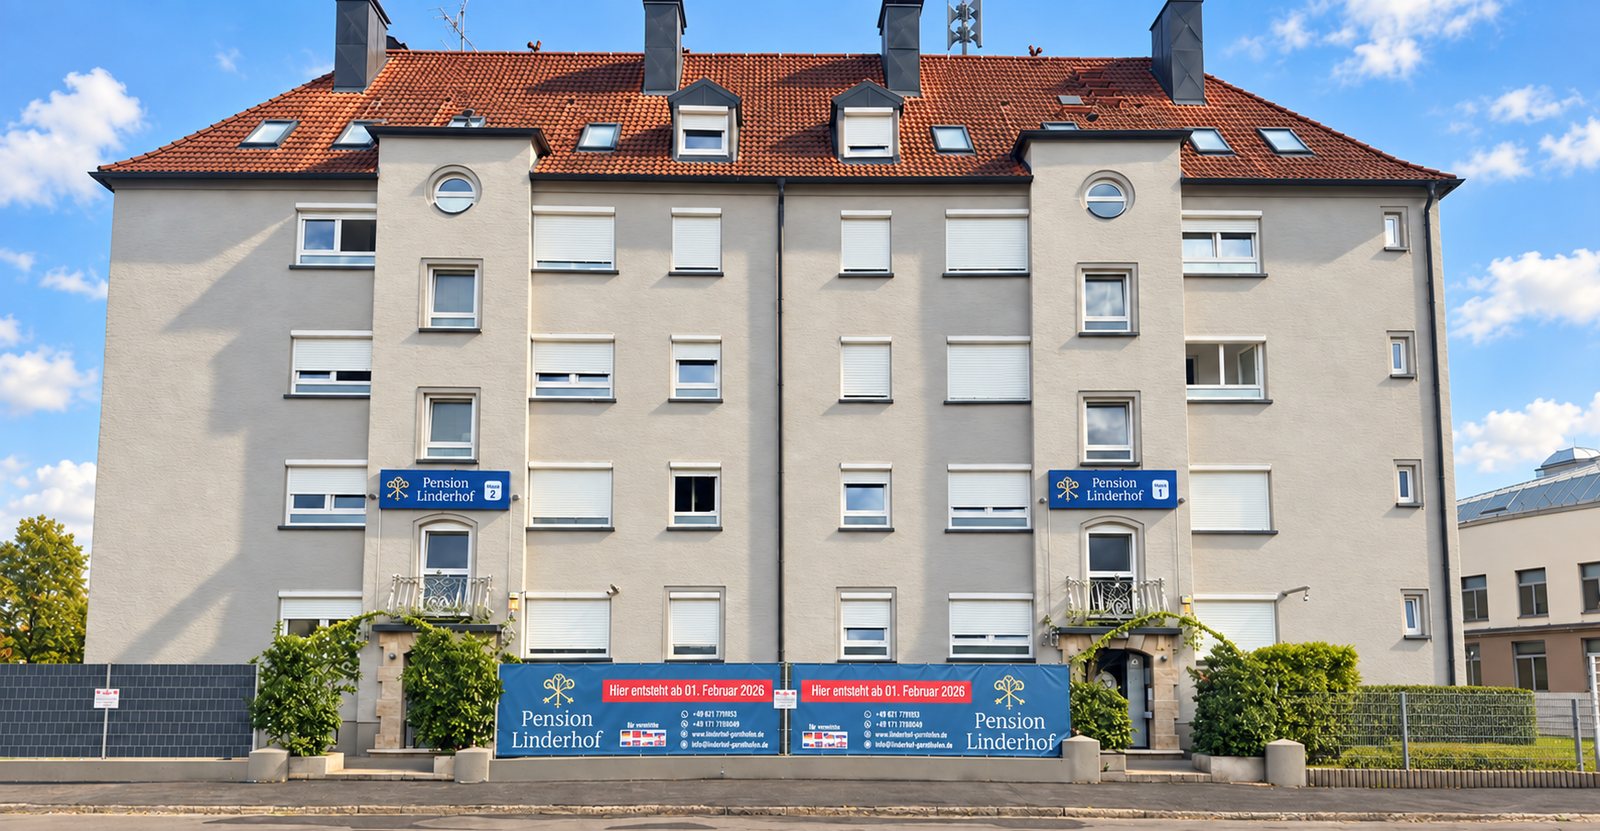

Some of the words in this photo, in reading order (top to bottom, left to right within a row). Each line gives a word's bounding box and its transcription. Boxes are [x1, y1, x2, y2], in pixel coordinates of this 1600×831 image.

[423, 477, 469, 489] Pension
[1092, 477, 1137, 489] Pension
[416, 490, 476, 502] Linderhof
[490, 489, 496, 499] 2
[1087, 490, 1144, 501] Linderhof
[1158, 488, 1162, 498] 1
[609, 684, 629, 697] Hier
[631, 684, 669, 697] entsteht
[670, 684, 683, 697] ab
[684, 684, 700, 697] 01.
[702, 684, 738, 697] Februar
[740, 684, 765, 697] 2026
[811, 684, 831, 697] Hier
[833, 684, 869, 697] entsteht
[871, 684, 883, 697] ab
[885, 685, 900, 697] 01.
[902, 684, 939, 698] Februar
[941, 685, 965, 698] 2026
[521, 710, 593, 727] Pension
[975, 711, 1046, 729] Pension
[512, 730, 604, 749] Linderhof
[966, 732, 1057, 751] Linderhof
